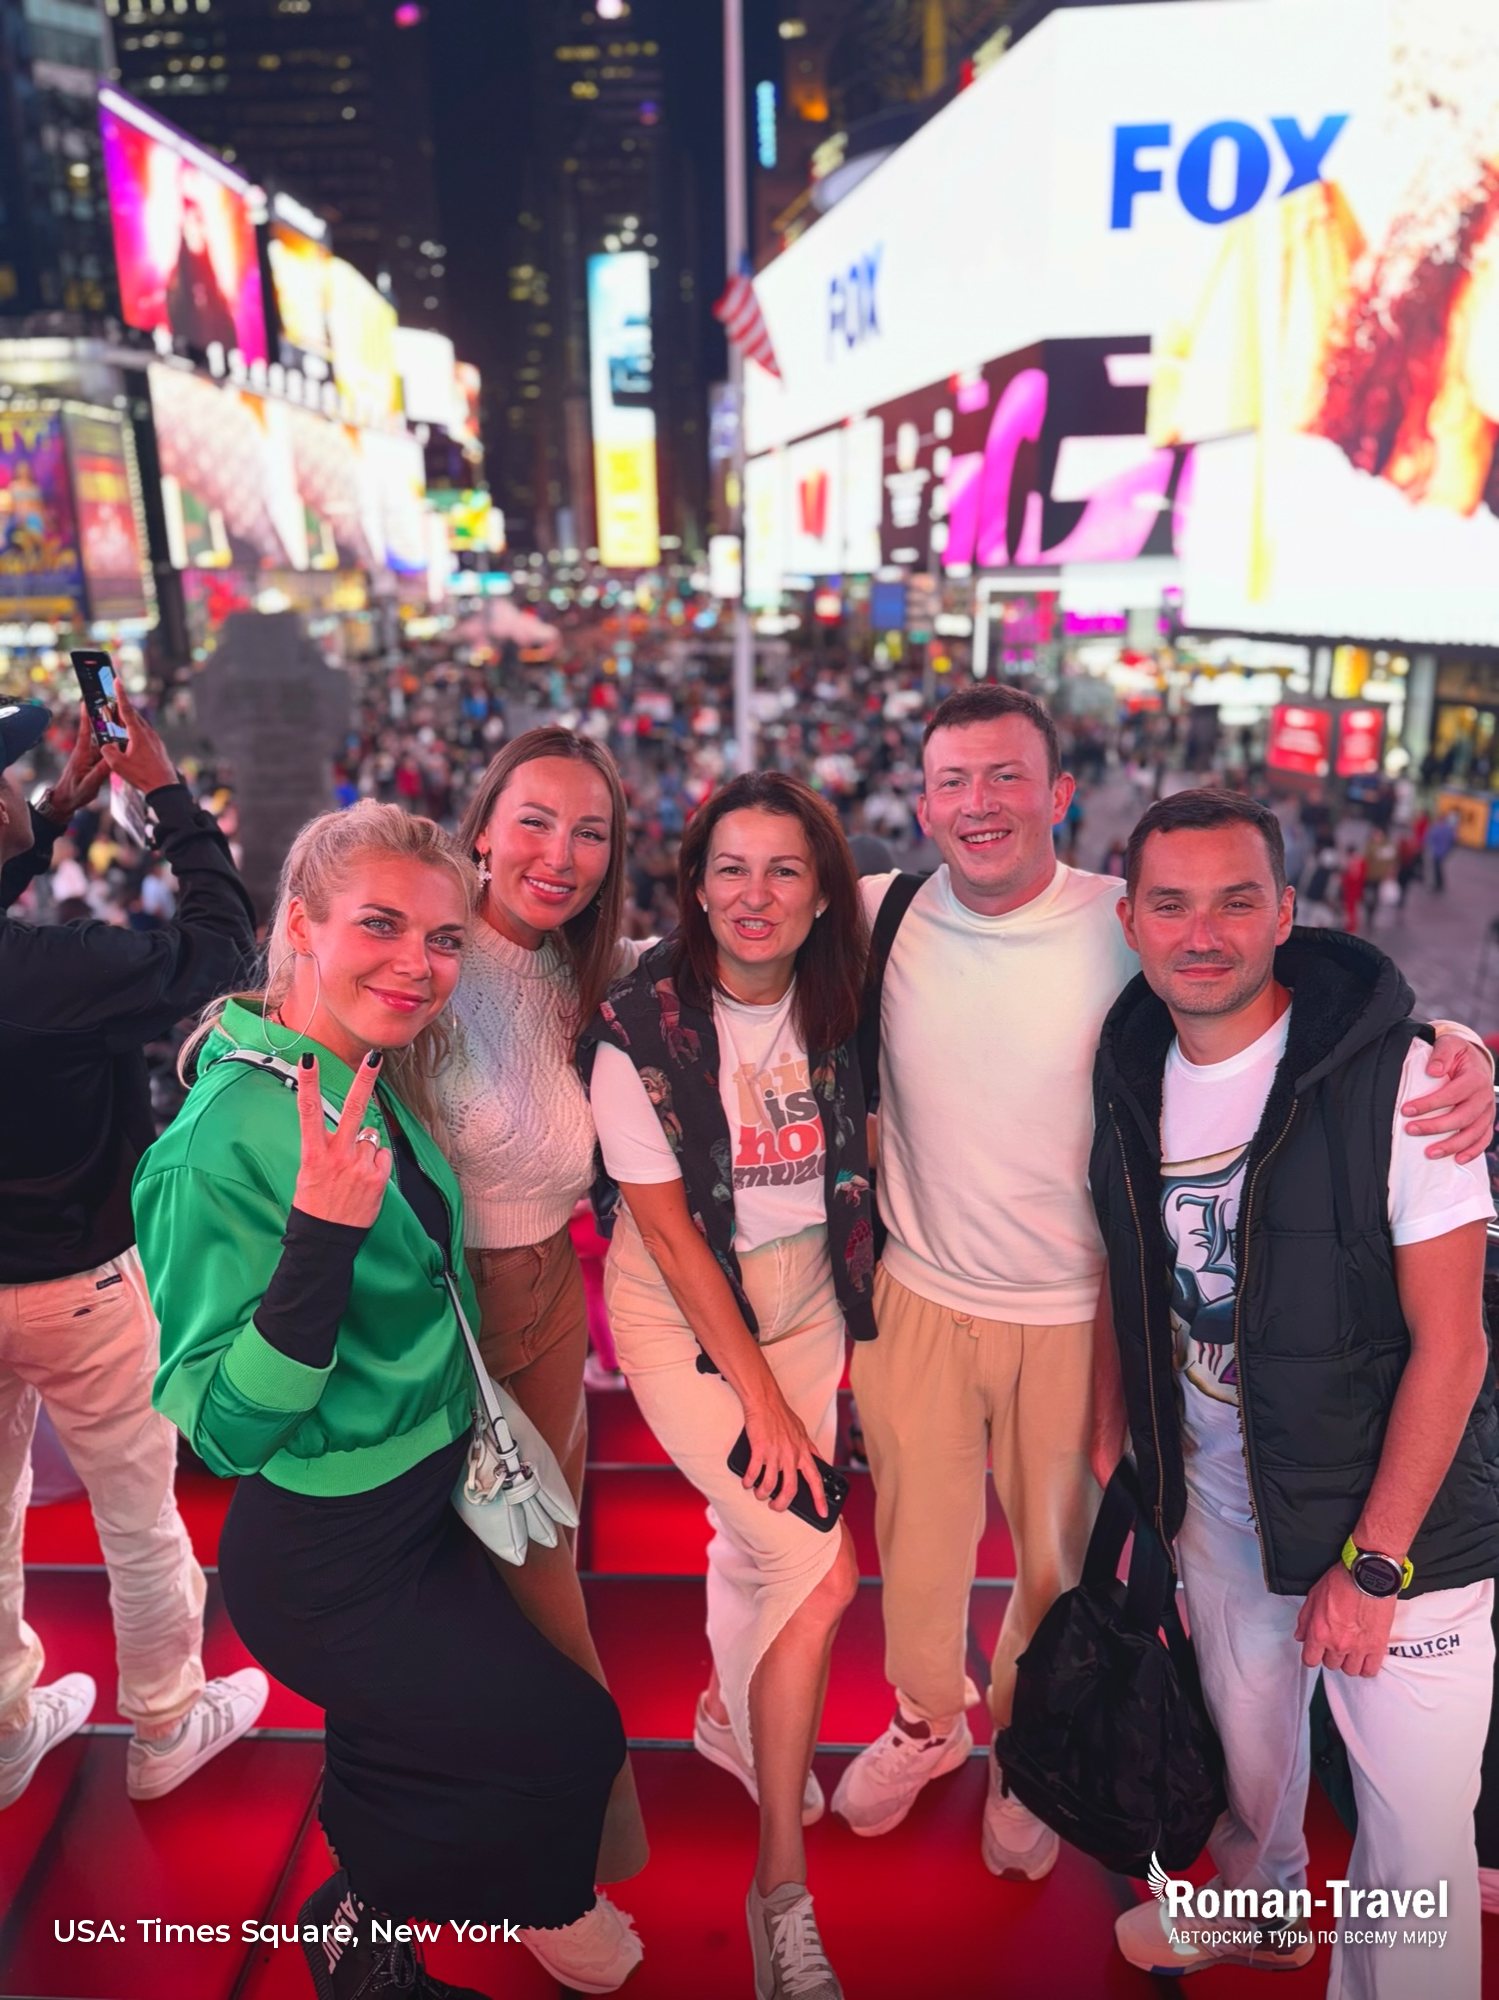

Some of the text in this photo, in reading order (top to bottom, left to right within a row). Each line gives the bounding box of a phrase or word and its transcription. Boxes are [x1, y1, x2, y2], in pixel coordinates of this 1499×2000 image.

[1109, 112, 1350, 231] FOX
[826, 240, 887, 360] FOX
[735, 1114, 826, 1166] ho
[1388, 1633, 1461, 1659] KLUTCH
